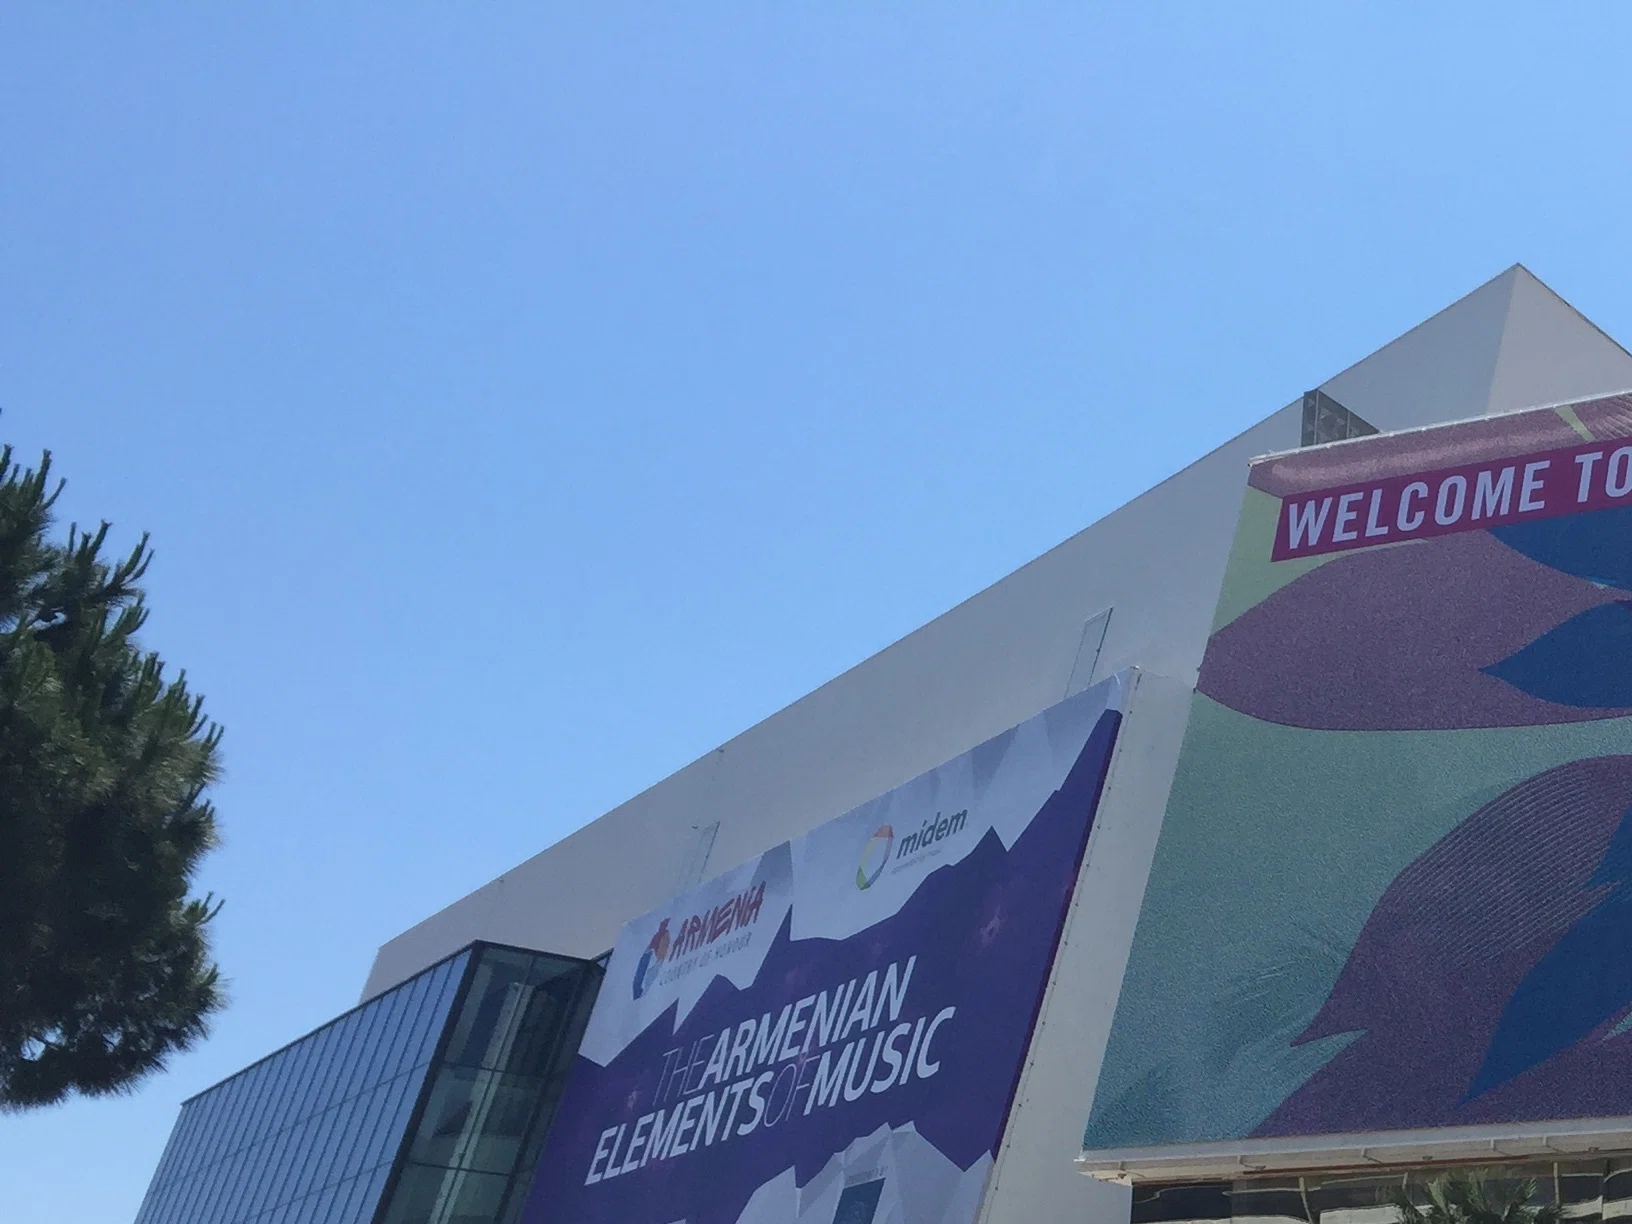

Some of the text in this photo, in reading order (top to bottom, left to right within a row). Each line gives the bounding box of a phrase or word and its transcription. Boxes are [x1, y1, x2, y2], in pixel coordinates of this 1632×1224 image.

[1286, 459, 1552, 551] WELCOME
[896, 809, 968, 859] midem
[669, 881, 766, 963] ARMENIA
